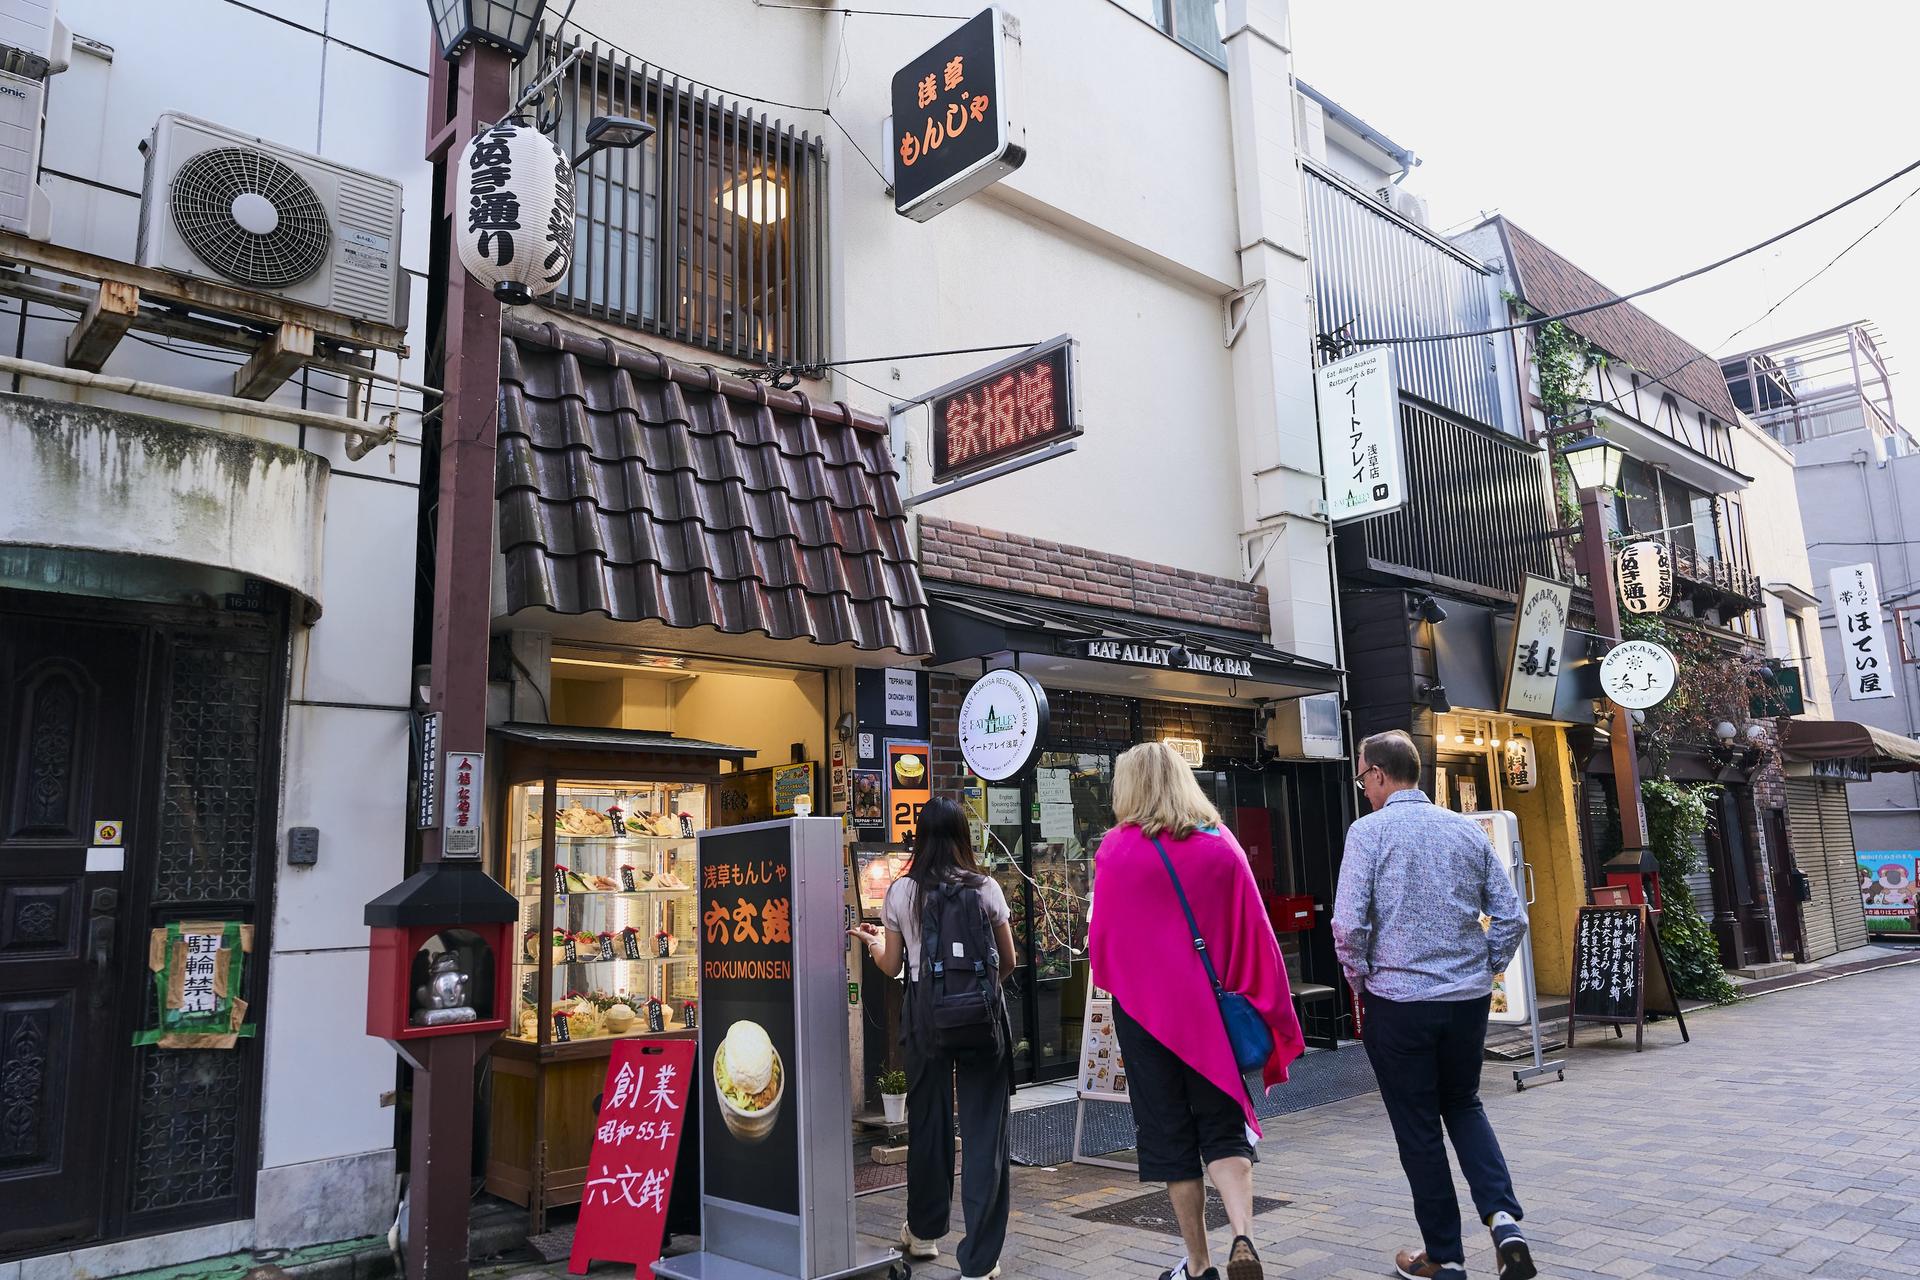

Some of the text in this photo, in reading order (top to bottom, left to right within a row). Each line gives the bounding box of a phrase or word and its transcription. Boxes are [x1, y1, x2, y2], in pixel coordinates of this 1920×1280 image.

[0, 86, 26, 98] onic
[918, 55, 964, 109] 浅草
[900, 91, 989, 166] もんじゃ
[469, 126, 521, 266] たぬき通り
[1366, 367, 1377, 375] Bar
[1346, 381, 1365, 483] イートアレイ
[1367, 443, 1380, 480] 浅草店
[1376, 487, 1386, 497] 1F
[1621, 546, 1647, 611] たぬき通り
[1524, 588, 1566, 627] UNAKAMI
[1840, 590, 1853, 606] 帯
[1186, 653, 1212, 672] INE
[1213, 657, 1224, 673] &
[1225, 658, 1254, 677] BAR
[1606, 645, 1663, 667] UNAKAMI
[1847, 611, 1882, 694] ほてい屋
[995, 677, 1025, 703] RESTAURANT
[970, 739, 1018, 752] イートアレイ浅草
[704, 860, 787, 889] 浅草もんじゃ
[705, 960, 791, 979] ROKUMONSEN
[1622, 913, 1638, 997] 新鮮な刺身
[183, 934, 217, 1014] 駐輪禁止
[606, 1062, 680, 1113] 創業
[597, 1119, 675, 1150] 昭和55年
[587, 1164, 670, 1214] 六文銭
